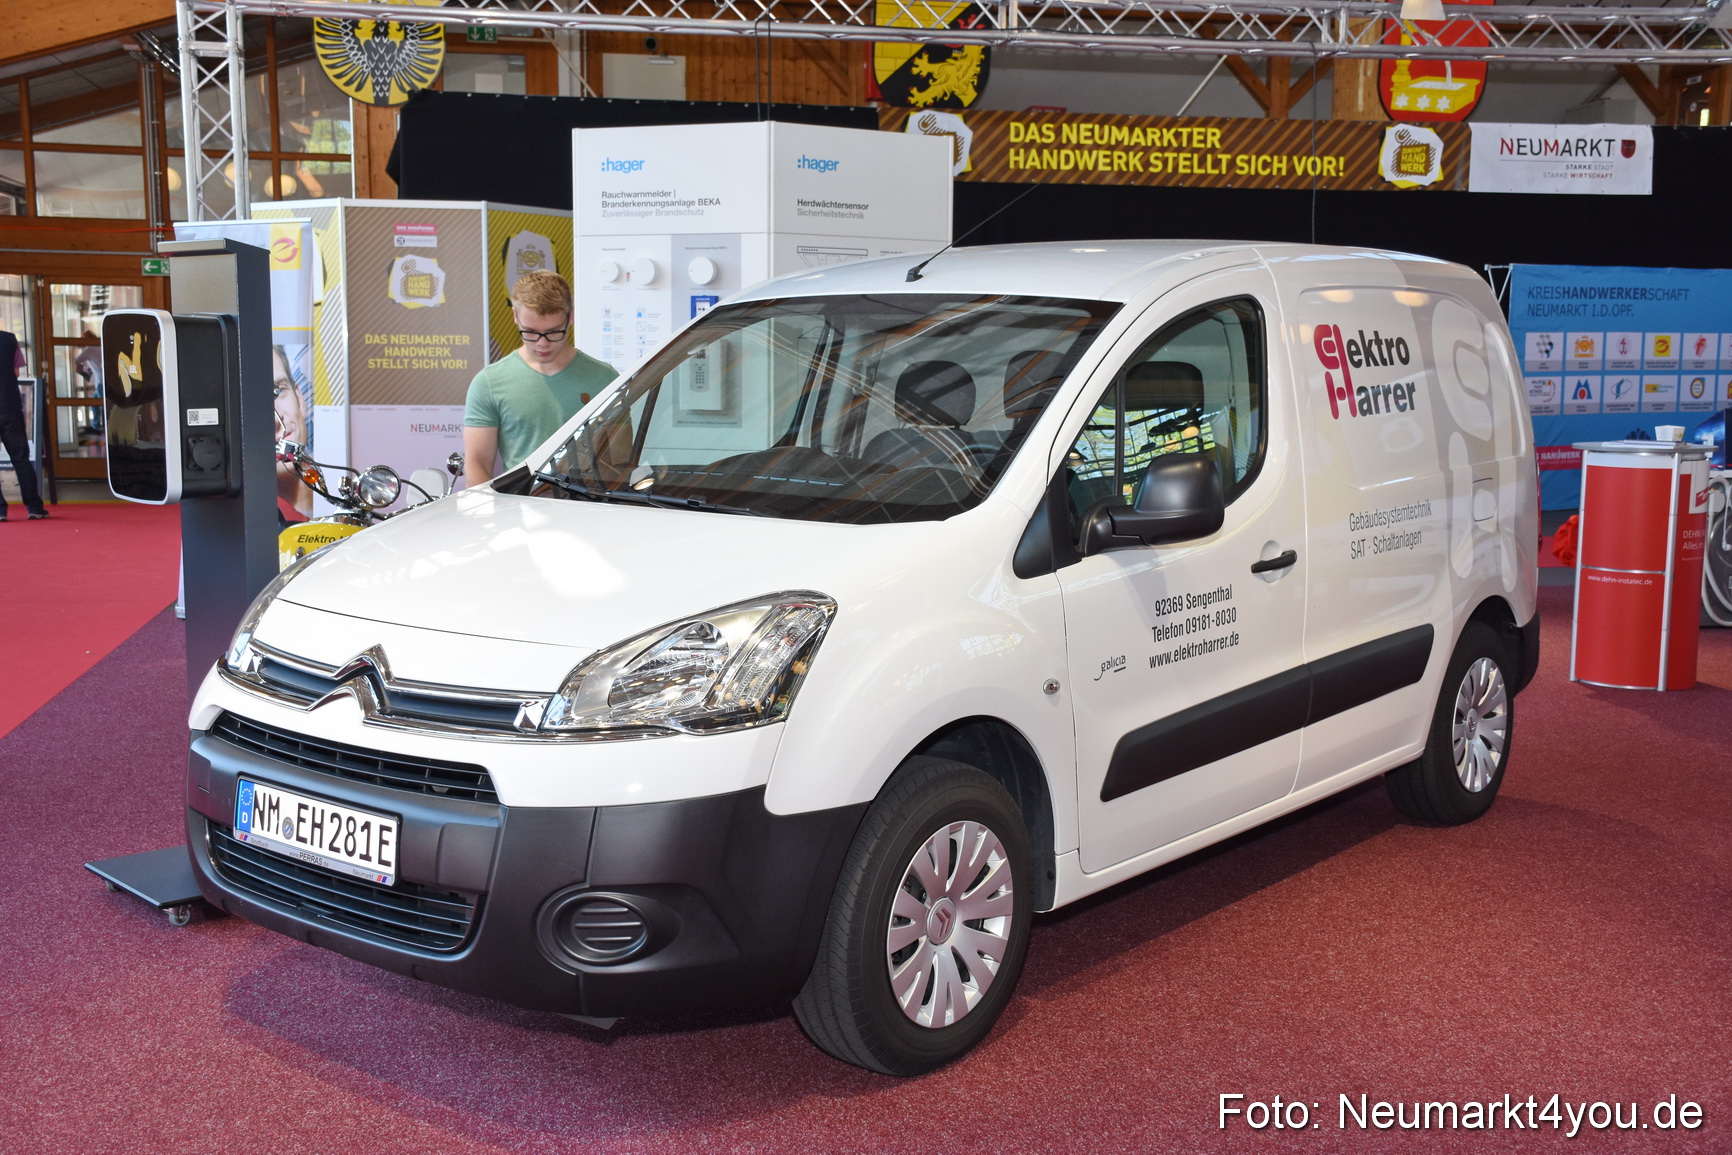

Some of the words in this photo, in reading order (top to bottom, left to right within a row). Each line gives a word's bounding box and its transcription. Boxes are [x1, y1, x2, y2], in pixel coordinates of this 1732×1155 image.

[1009, 122, 1056, 144] DAS
[1061, 123, 1222, 149] NEUMARKTER
[1500, 138, 1616, 157] NEUMARKT
[1009, 149, 1144, 172] HANDWERK
[1149, 152, 1231, 175] STELLT
[1235, 154, 1287, 176] SICH
[1292, 156, 1345, 177] VOR!
[1402, 153, 1426, 163] HAND
[1401, 163, 1425, 173] WERK
[601, 190, 672, 199] Rauchwarnmelder
[601, 199, 696, 208] Branderkennungsanlage
[697, 198, 721, 206] BEKA
[797, 199, 869, 210] Herdwächtersensor
[601, 209, 653, 218] Zuverlässiger
[655, 208, 705, 216] Brandschutz
[797, 208, 865, 219] Sicherheitstechnik
[1528, 286, 1690, 300] KREISHANDWERKERSCHAFT
[1527, 304, 1588, 317] NEUMARKT
[365, 334, 388, 344] DAS
[390, 334, 470, 345] NEUMARKTER
[384, 347, 451, 357] HANDWERK
[368, 359, 409, 369] STELLT
[412, 359, 438, 369] SICH
[441, 359, 468, 369] VOR!
[410, 424, 464, 433] NEUMARK
[1349, 499, 1432, 532] Gebäudesystemtechnik
[298, 535, 336, 543] Elektro
[1350, 538, 1366, 560] SAT
[1373, 530, 1422, 555] Schaltanlagen
[1587, 575, 1653, 586] www.dehn-instatec.de
[1155, 595, 1183, 617] 92369
[1186, 583, 1233, 610] Sengenthal
[1152, 622, 1184, 643] Telefon
[1185, 607, 1237, 634] 09181-8030
[1149, 631, 1239, 669] www.elektroharrer.de
[241, 812, 249, 824] D
[252, 790, 280, 835] NM
